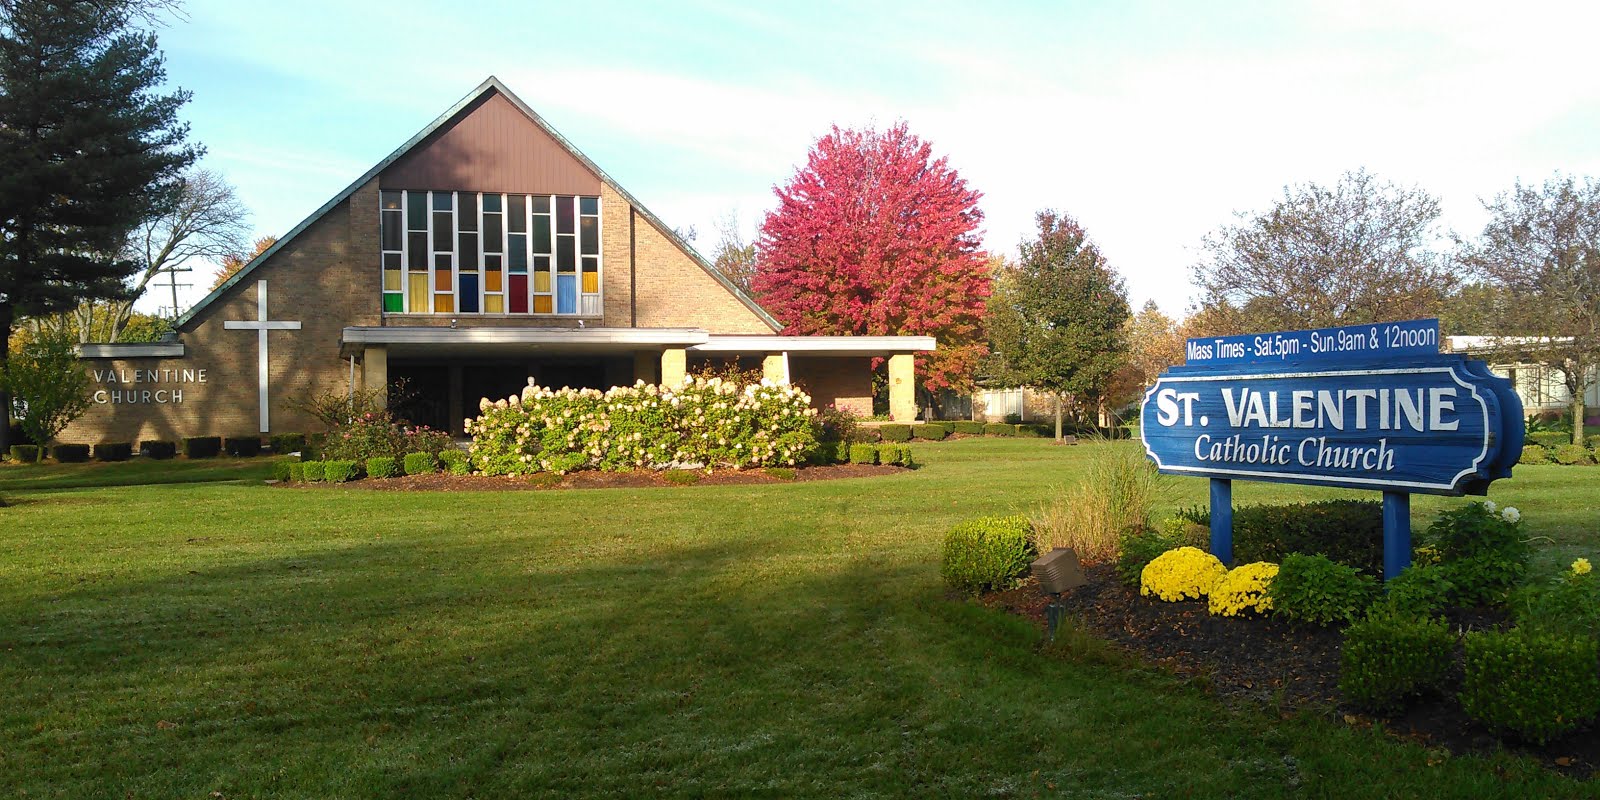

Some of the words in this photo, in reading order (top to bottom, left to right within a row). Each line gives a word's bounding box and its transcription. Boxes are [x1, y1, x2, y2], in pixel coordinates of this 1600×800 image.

[1187, 342, 1213, 360] Mass
[1215, 340, 1245, 359] Times
[1254, 335, 1300, 359] Sat.5pm
[1310, 329, 1366, 353] Sun.9am
[1369, 327, 1379, 348] &
[1384, 325, 1436, 348] 12noon
[93, 368, 207, 383] VALENTINE
[93, 389, 183, 404] CHURCH
[1157, 388, 1209, 427] ST.
[1221, 387, 1460, 431] VALENTINE
[1194, 434, 1291, 466] Catholic
[1297, 437, 1395, 471] Church
